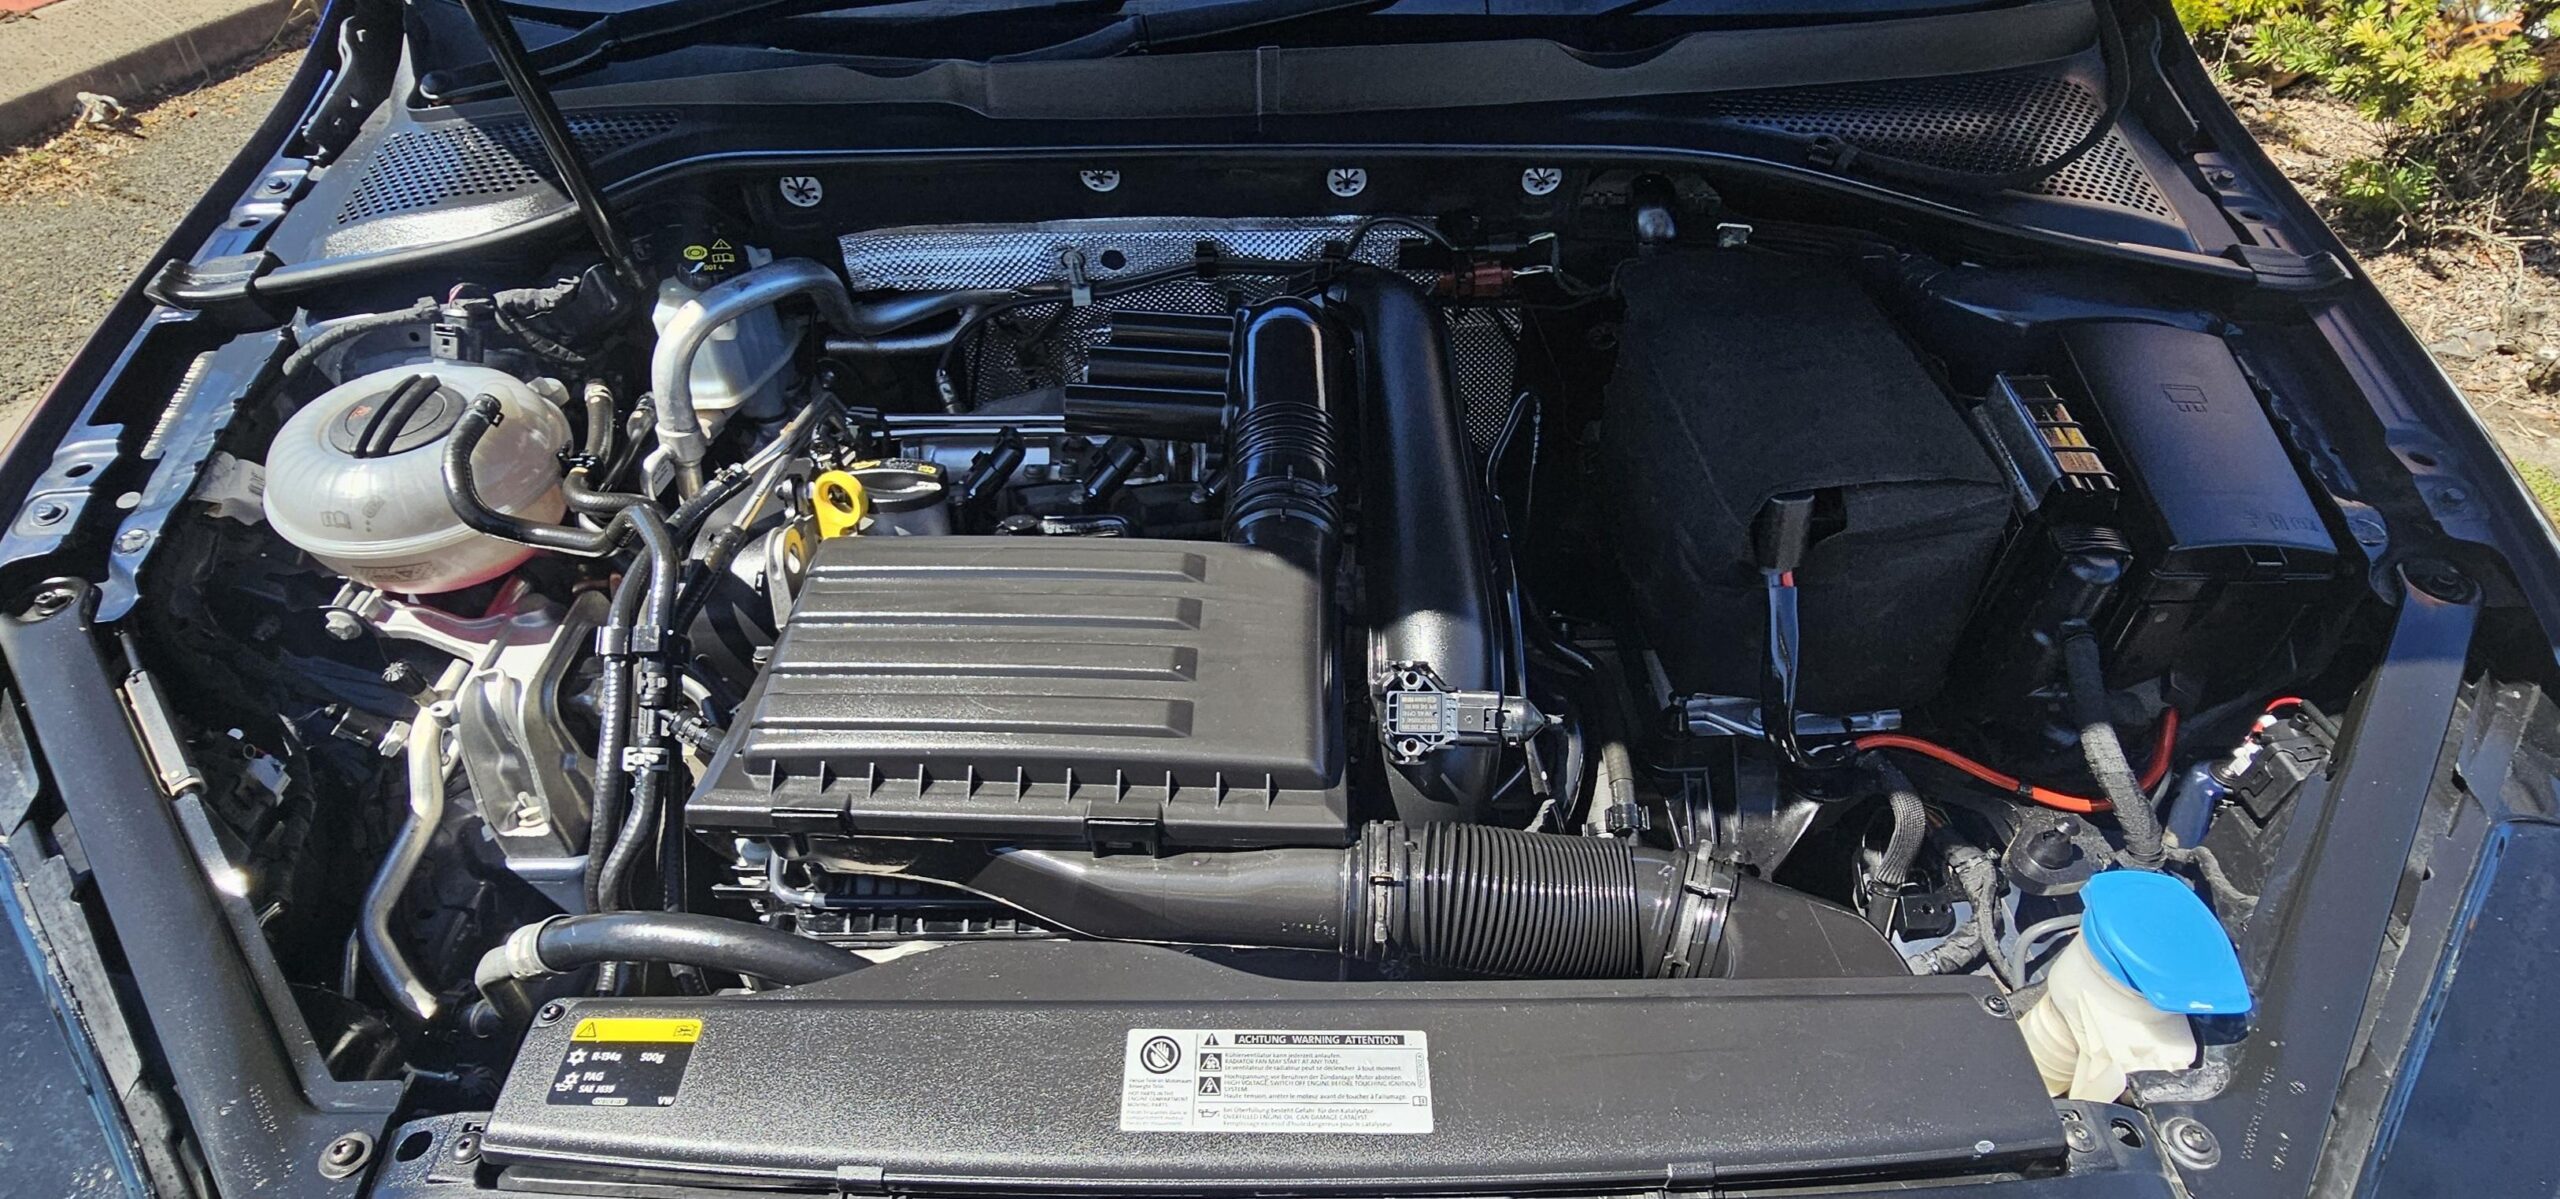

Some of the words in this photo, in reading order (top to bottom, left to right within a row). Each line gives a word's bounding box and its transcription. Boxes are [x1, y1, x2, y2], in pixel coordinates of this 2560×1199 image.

[1238, 1035, 1286, 1044] ACHTUNG
[1292, 1035, 1340, 1044] WARNING
[1345, 1036, 1398, 1045] ATTENTION
[591, 1052, 622, 1062] R-134a
[639, 1052, 665, 1064] 500g
[583, 1072, 605, 1081] PAG
[578, 1085, 595, 1093] SAE
[657, 1096, 675, 1105] VW
